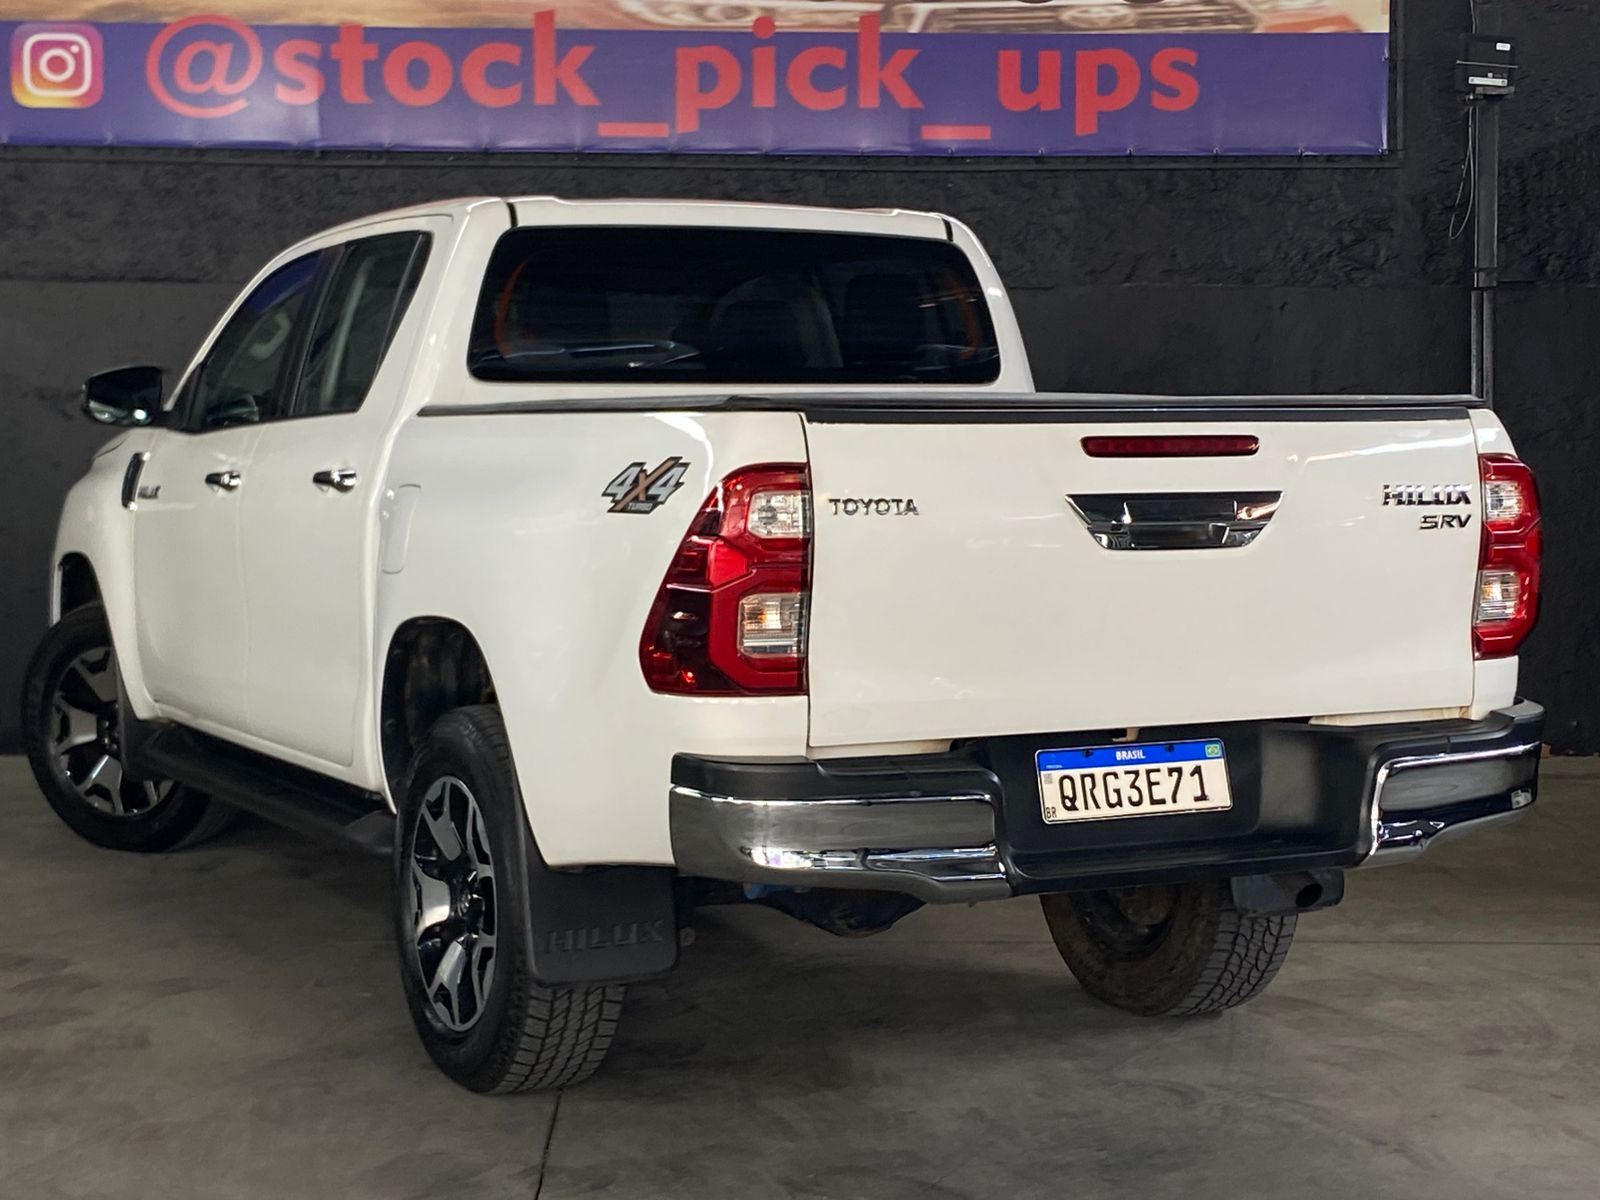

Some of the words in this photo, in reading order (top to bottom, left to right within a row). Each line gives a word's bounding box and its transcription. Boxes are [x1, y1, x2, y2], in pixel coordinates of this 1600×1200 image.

[145, 9, 1200, 139] @stock_pick_ups
[1382, 483, 1472, 506] HILUX
[828, 498, 919, 516] TOYOTA
[1419, 514, 1471, 530] SRV
[1115, 749, 1146, 761] BRASIL
[1058, 765, 1210, 812] QRG3E71
[547, 920, 664, 954] HILUX
